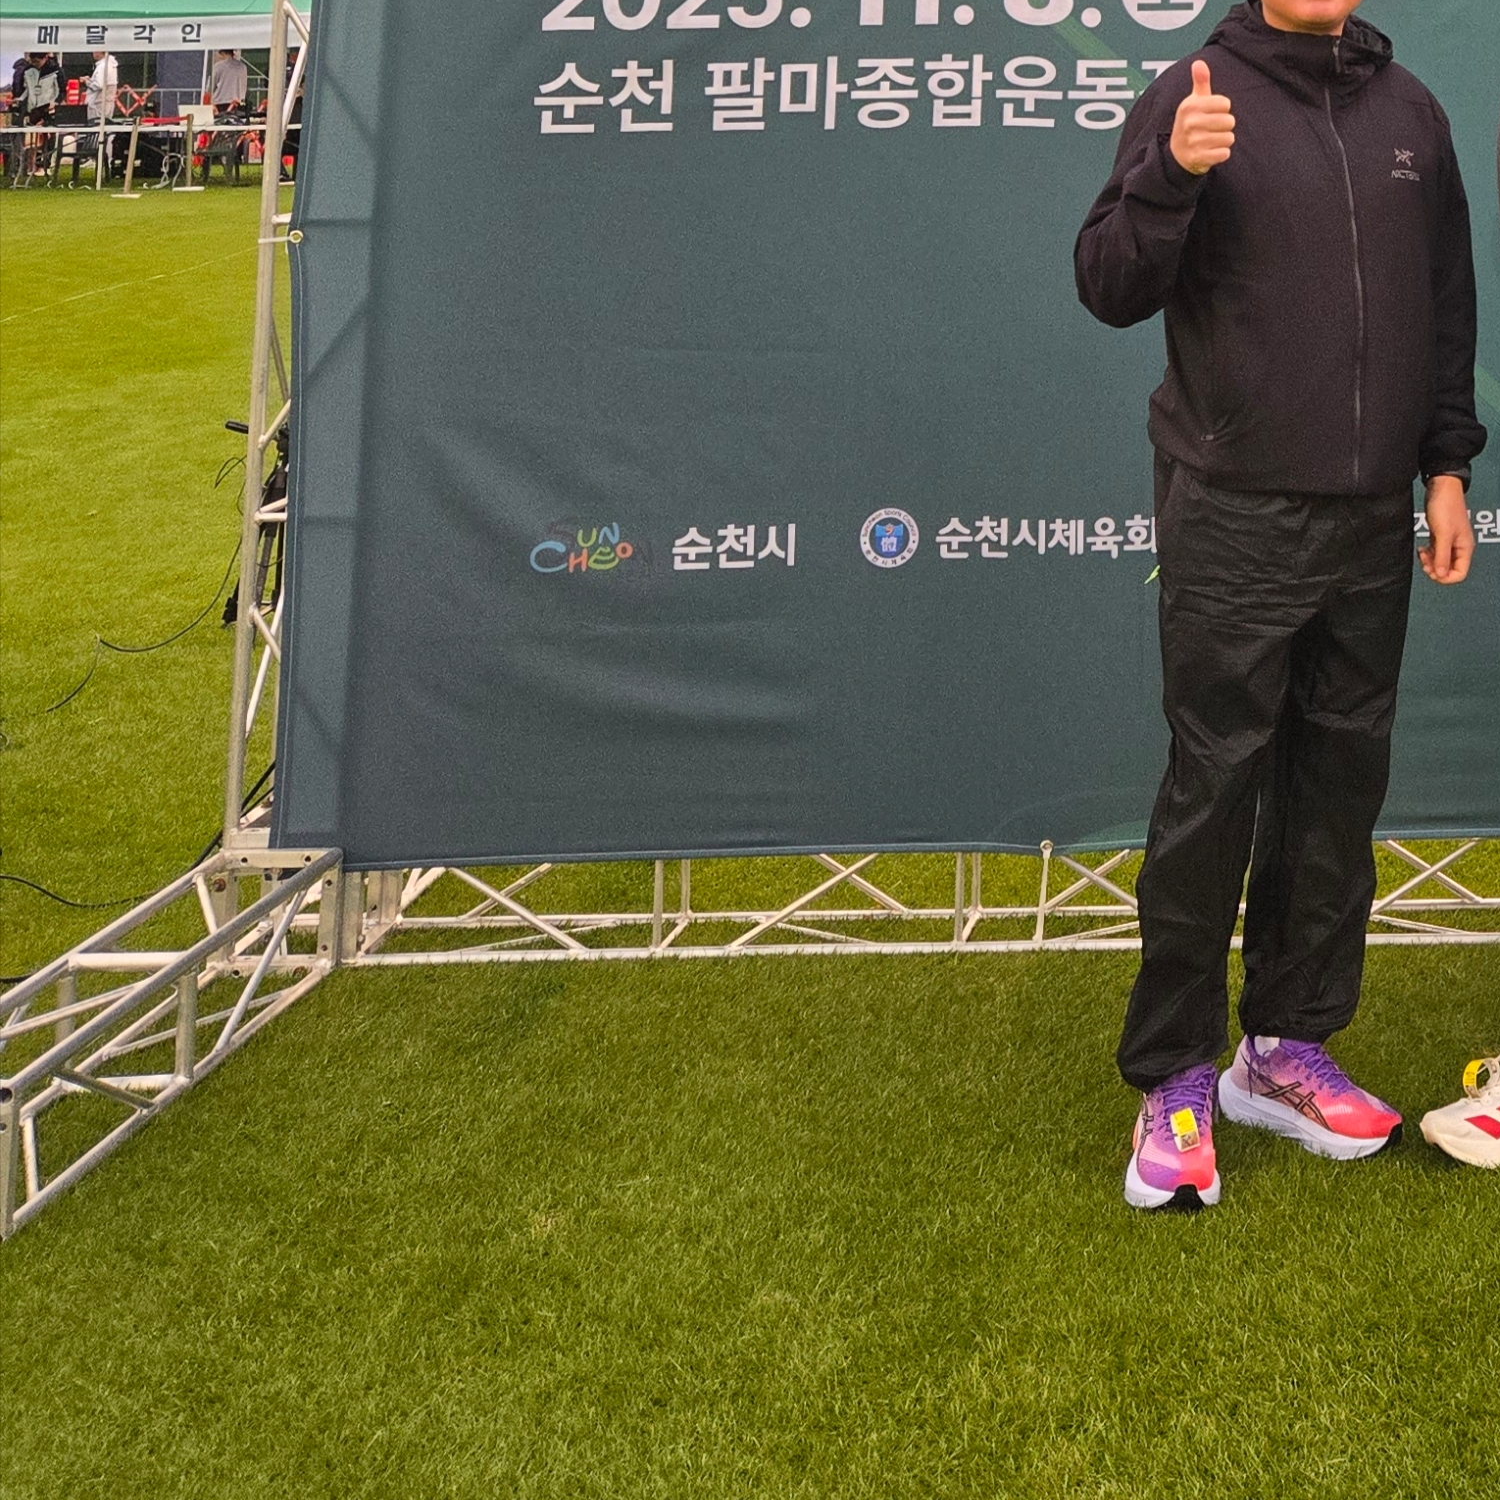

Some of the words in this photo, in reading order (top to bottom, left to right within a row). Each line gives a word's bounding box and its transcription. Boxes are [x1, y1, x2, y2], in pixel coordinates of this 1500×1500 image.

[533, 59, 674, 135] 순천
[671, 522, 797, 571] 순천시
[935, 514, 1158, 560] 순천시체육회
